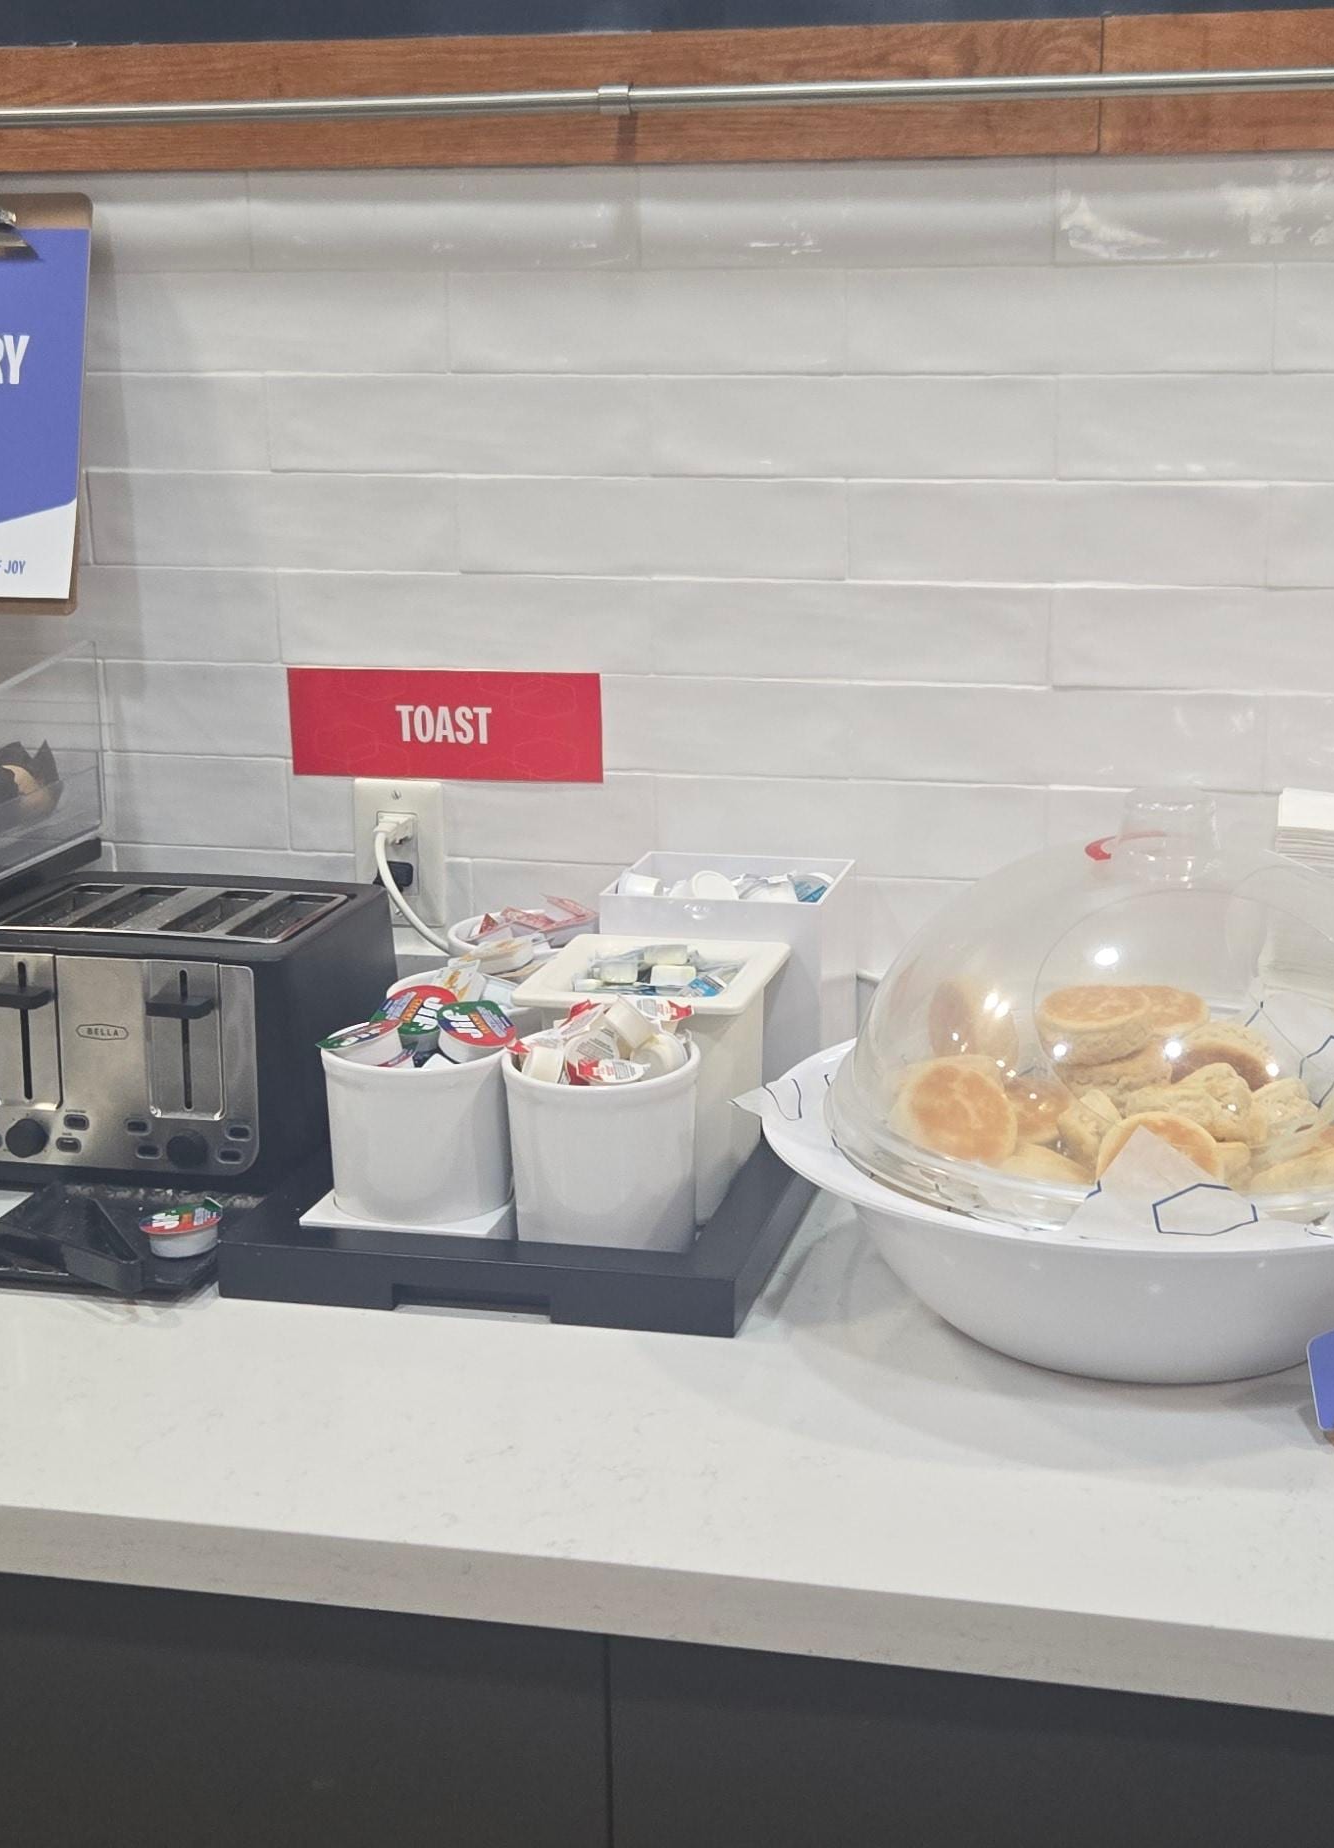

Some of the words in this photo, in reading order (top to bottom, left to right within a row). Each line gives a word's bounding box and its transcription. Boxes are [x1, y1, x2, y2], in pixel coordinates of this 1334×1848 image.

[4, 560, 26, 574] JOY
[395, 705, 492, 744] TOAST
[87, 1027, 119, 1037] BELLA
